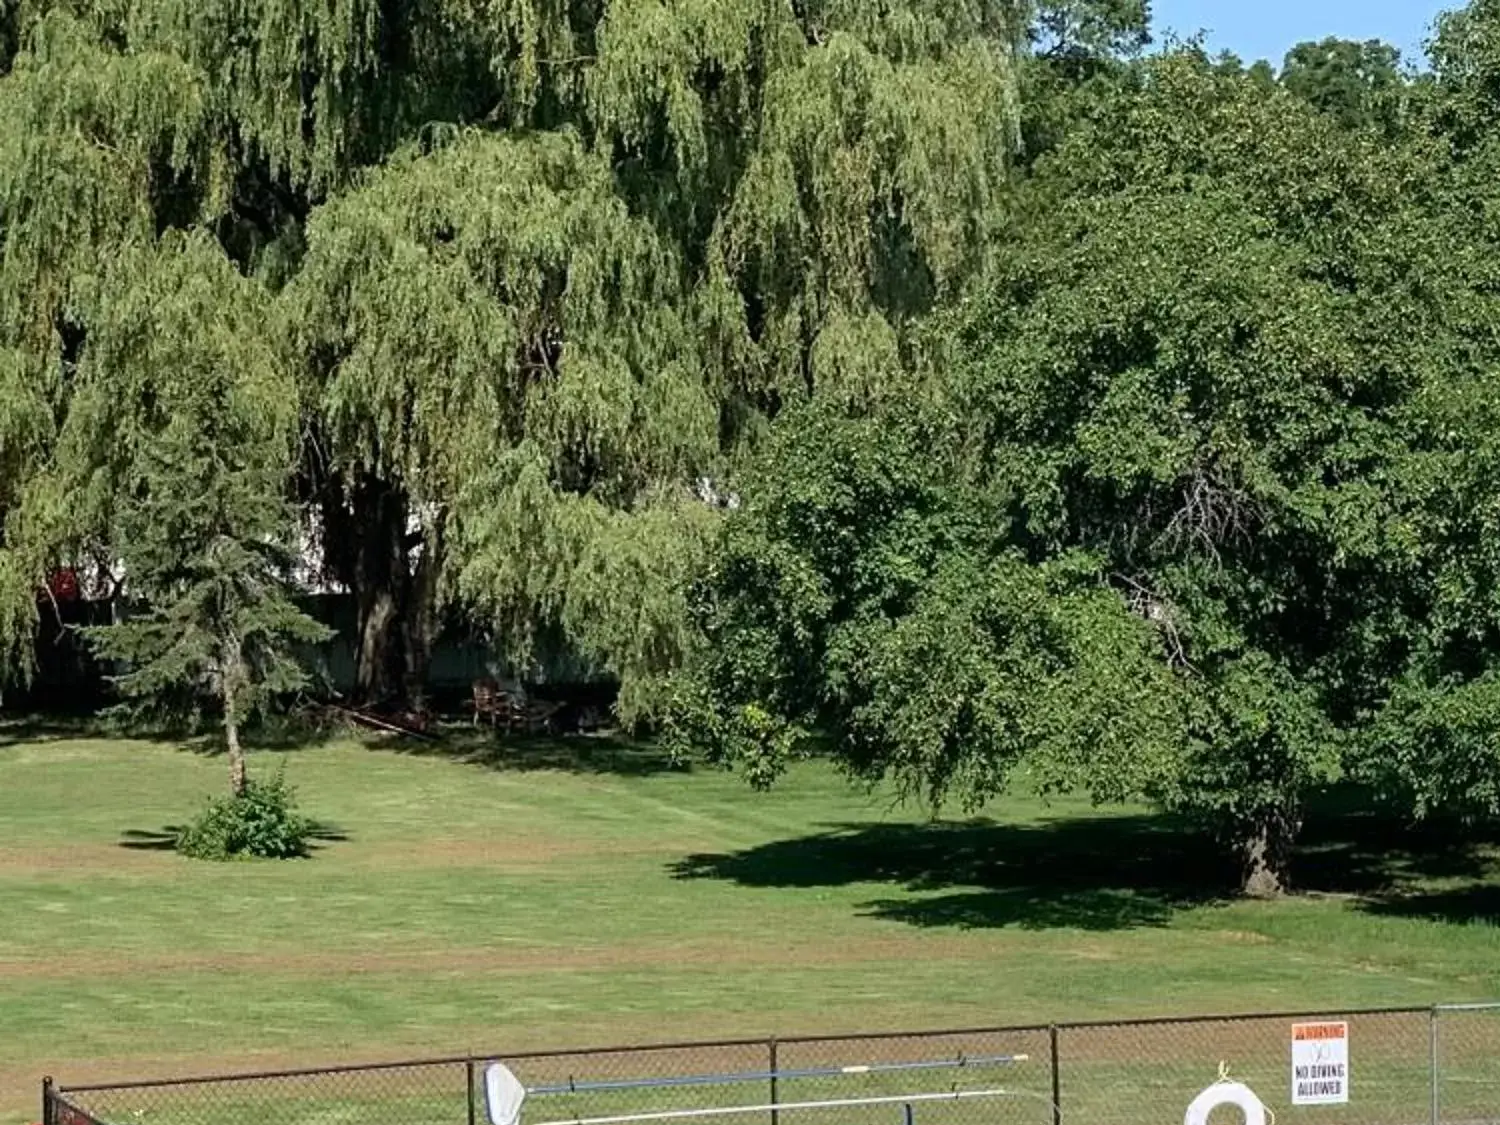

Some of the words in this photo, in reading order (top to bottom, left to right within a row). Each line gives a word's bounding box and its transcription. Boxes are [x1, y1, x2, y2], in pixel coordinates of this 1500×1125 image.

[1296, 1065, 1308, 1079] NO
[1311, 1064, 1345, 1079] DIVING
[1298, 1081, 1342, 1097] ALLOWED
